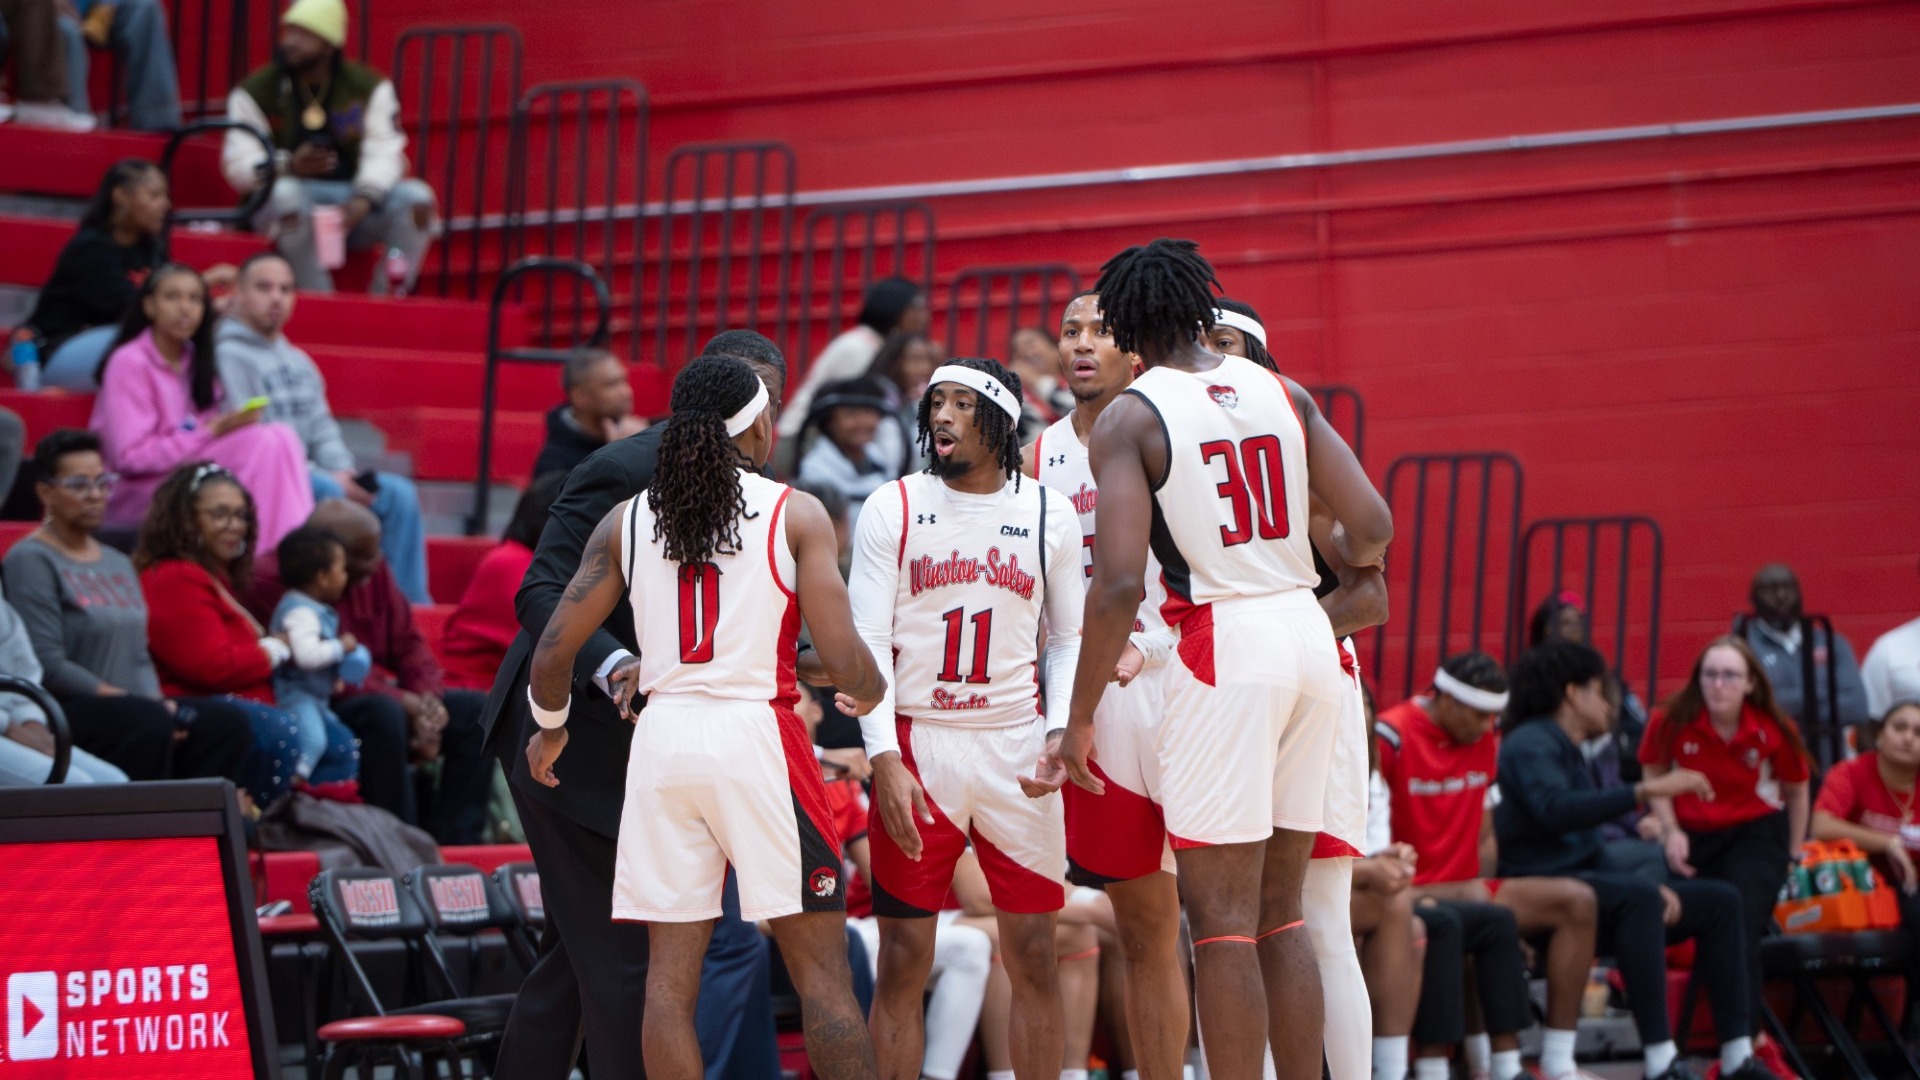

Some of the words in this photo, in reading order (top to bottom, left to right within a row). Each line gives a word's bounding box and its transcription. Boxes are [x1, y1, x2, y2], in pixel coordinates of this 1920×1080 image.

[1199, 434, 1290, 547] 30
[1000, 525, 1029, 538] CIAA
[909, 546, 1036, 600] Winston-Salem
[677, 560, 720, 664] 0
[937, 606, 993, 684] 11
[66, 963, 210, 1008] SPORTS
[66, 1011, 230, 1059] NETWORK
